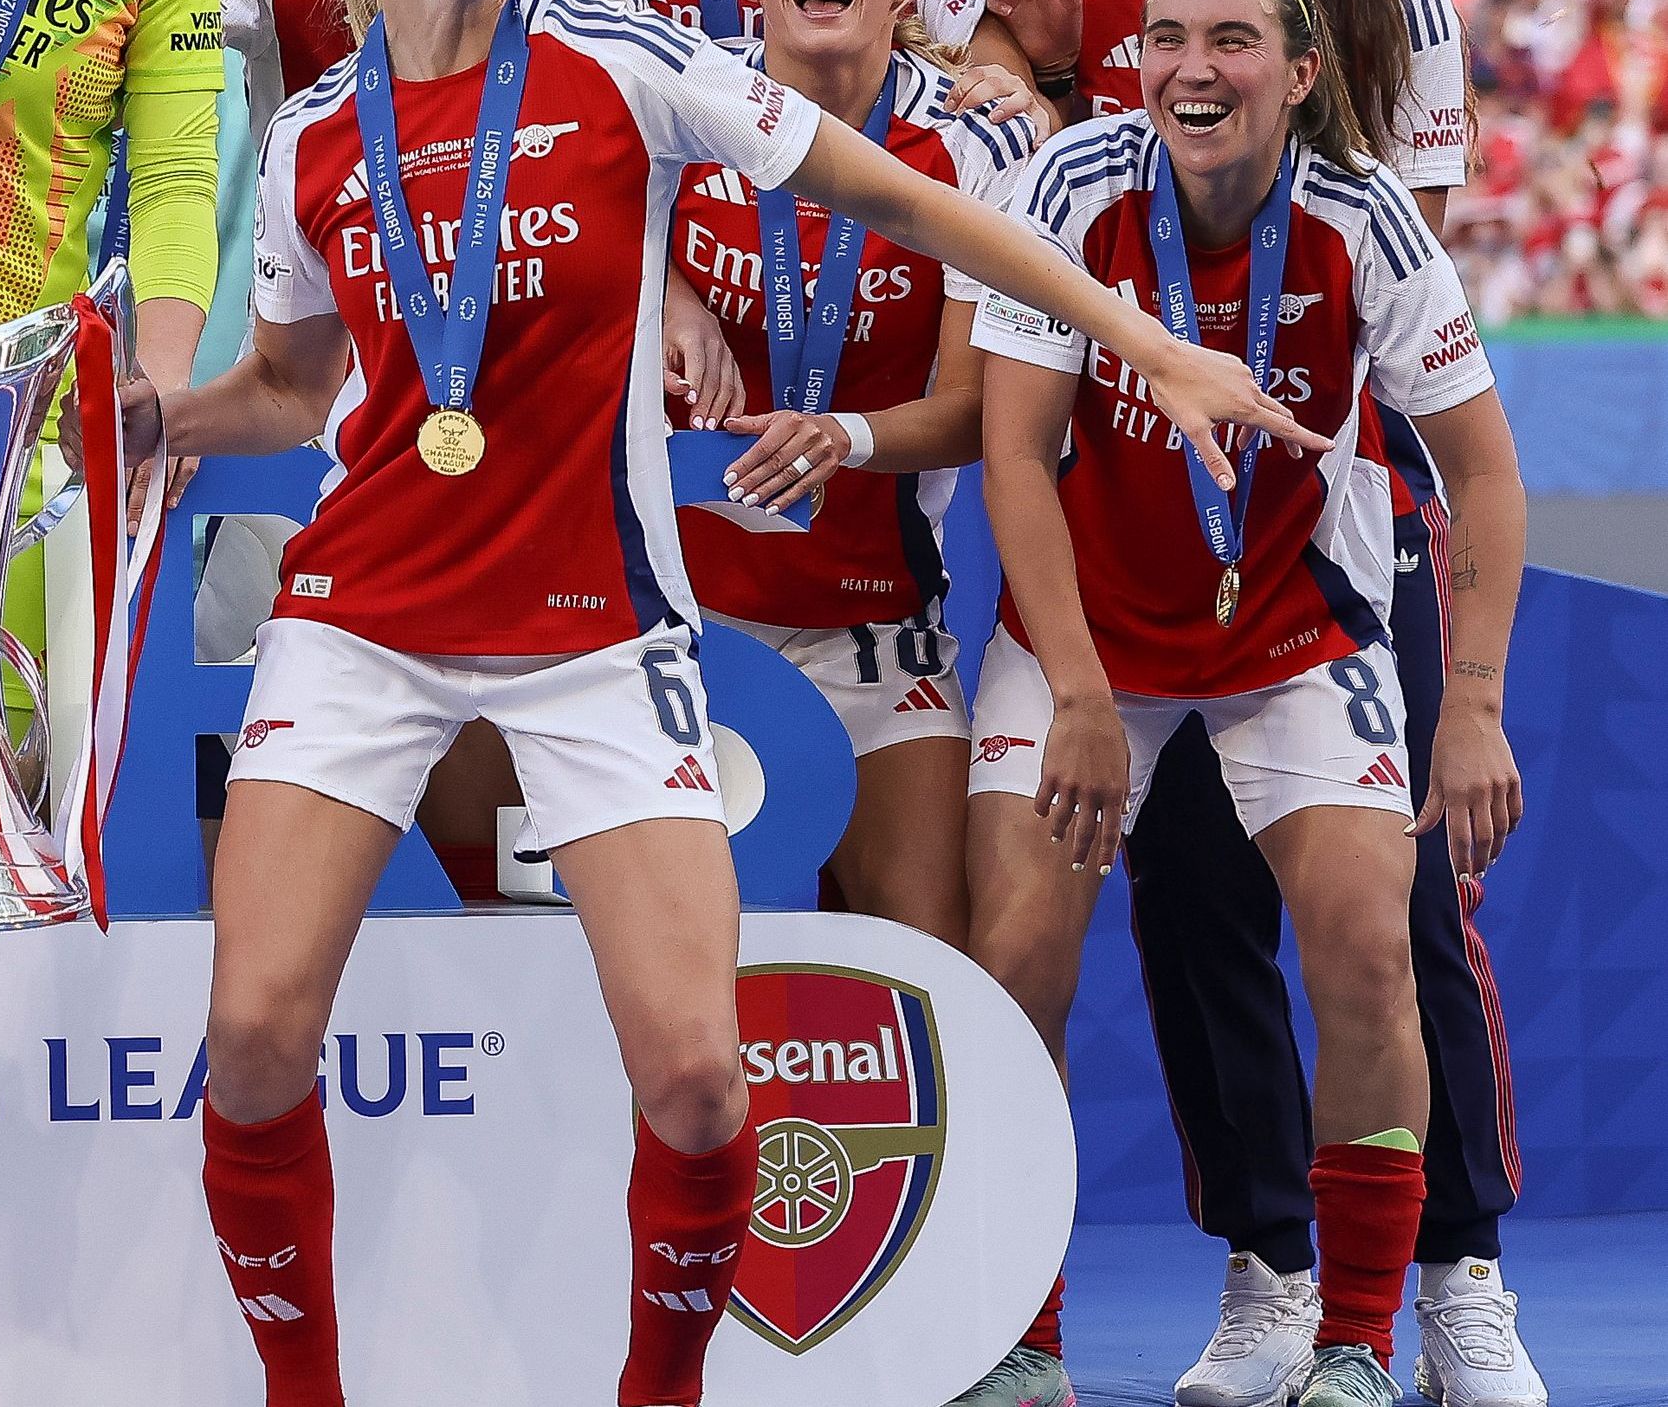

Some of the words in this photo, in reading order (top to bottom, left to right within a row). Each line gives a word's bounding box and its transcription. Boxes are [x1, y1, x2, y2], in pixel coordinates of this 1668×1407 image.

[373, 135, 386, 180] FINAL
[398, 150, 420, 166] INAL
[421, 139, 462, 157] LISBON
[481, 130, 503, 180] LISBON
[341, 202, 580, 279] Eirtes
[381, 198, 406, 251] LISBON
[471, 203, 488, 248] FINAL
[835, 217, 854, 258] FINAL
[686, 220, 913, 303] Emes
[773, 228, 785, 270] FINAL
[777, 292, 795, 341] LISBON
[985, 301, 1044, 327] FOUNDATION
[1168, 282, 1188, 332] LISBON
[1259, 294, 1271, 336] FINAL
[1437, 310, 1474, 345] VISIT
[1112, 400, 1159, 443] FLY
[424, 449, 476, 462] CHAMPIONS
[432, 457, 466, 469] LEAGUE
[547, 593, 607, 611] HEAT.RDY
[847, 622, 943, 685] 10
[1268, 629, 1321, 660] HEAT.RDY
[638, 644, 703, 748] 6
[1326, 653, 1398, 747] 8
[738, 1024, 901, 1086] rsenal
[649, 1239, 739, 1268] AFC
